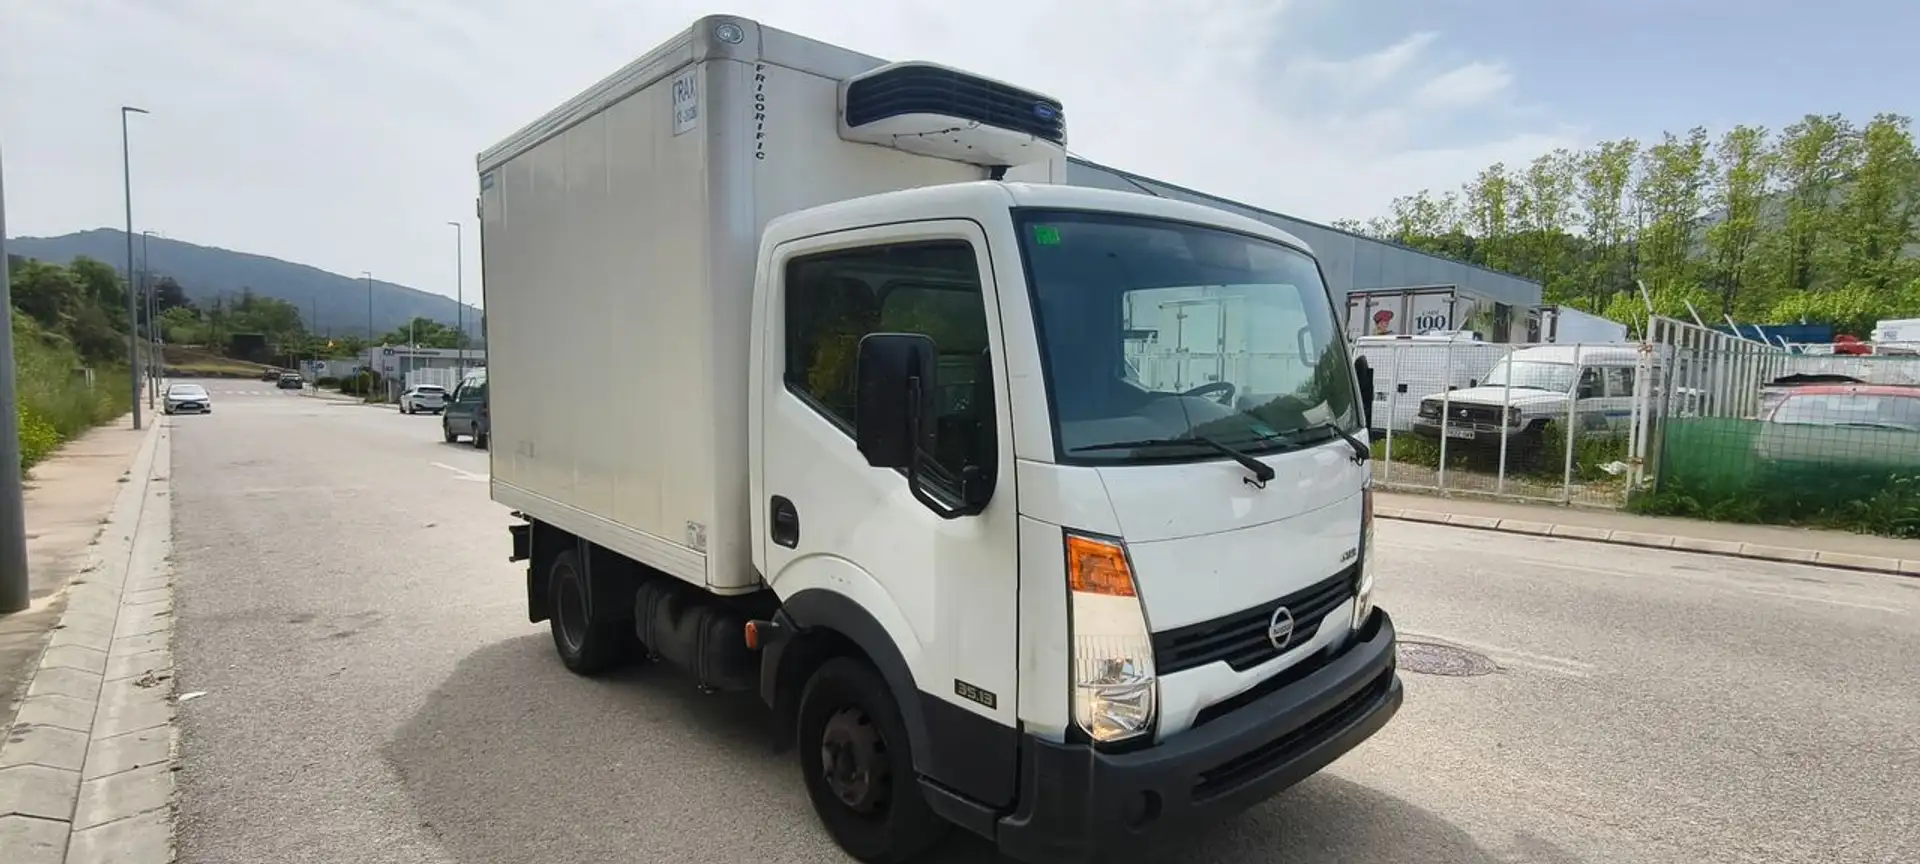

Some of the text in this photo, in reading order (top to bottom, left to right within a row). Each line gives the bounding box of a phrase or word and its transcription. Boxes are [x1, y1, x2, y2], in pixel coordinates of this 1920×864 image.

[755, 64, 766, 160] FRIGORIFIC
[1415, 314, 1446, 330] 100
[957, 681, 993, 706] 35.13
